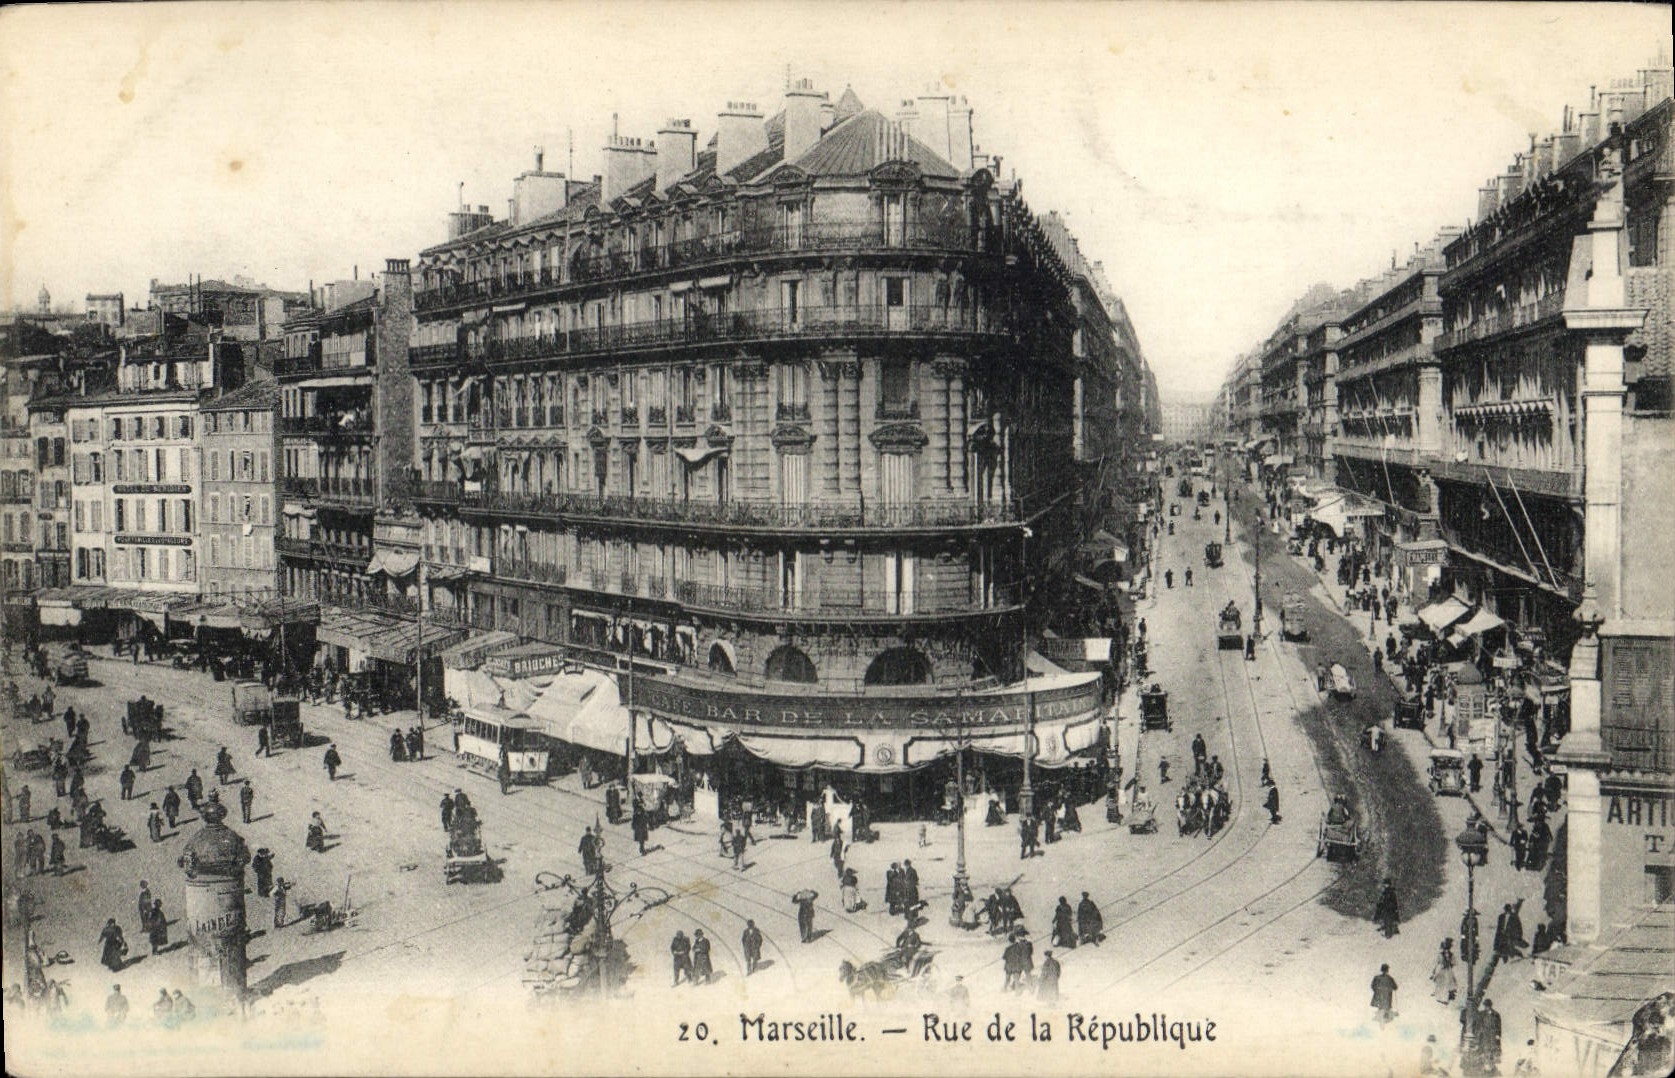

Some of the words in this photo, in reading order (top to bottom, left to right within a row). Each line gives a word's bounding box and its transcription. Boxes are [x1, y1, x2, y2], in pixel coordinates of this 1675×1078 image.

[514, 655, 565, 674] BRIOCHES
[706, 704, 761, 722] BAR
[780, 710, 822, 724] DE
[845, 711, 892, 725] LA
[1607, 796, 1675, 827] ARTI
